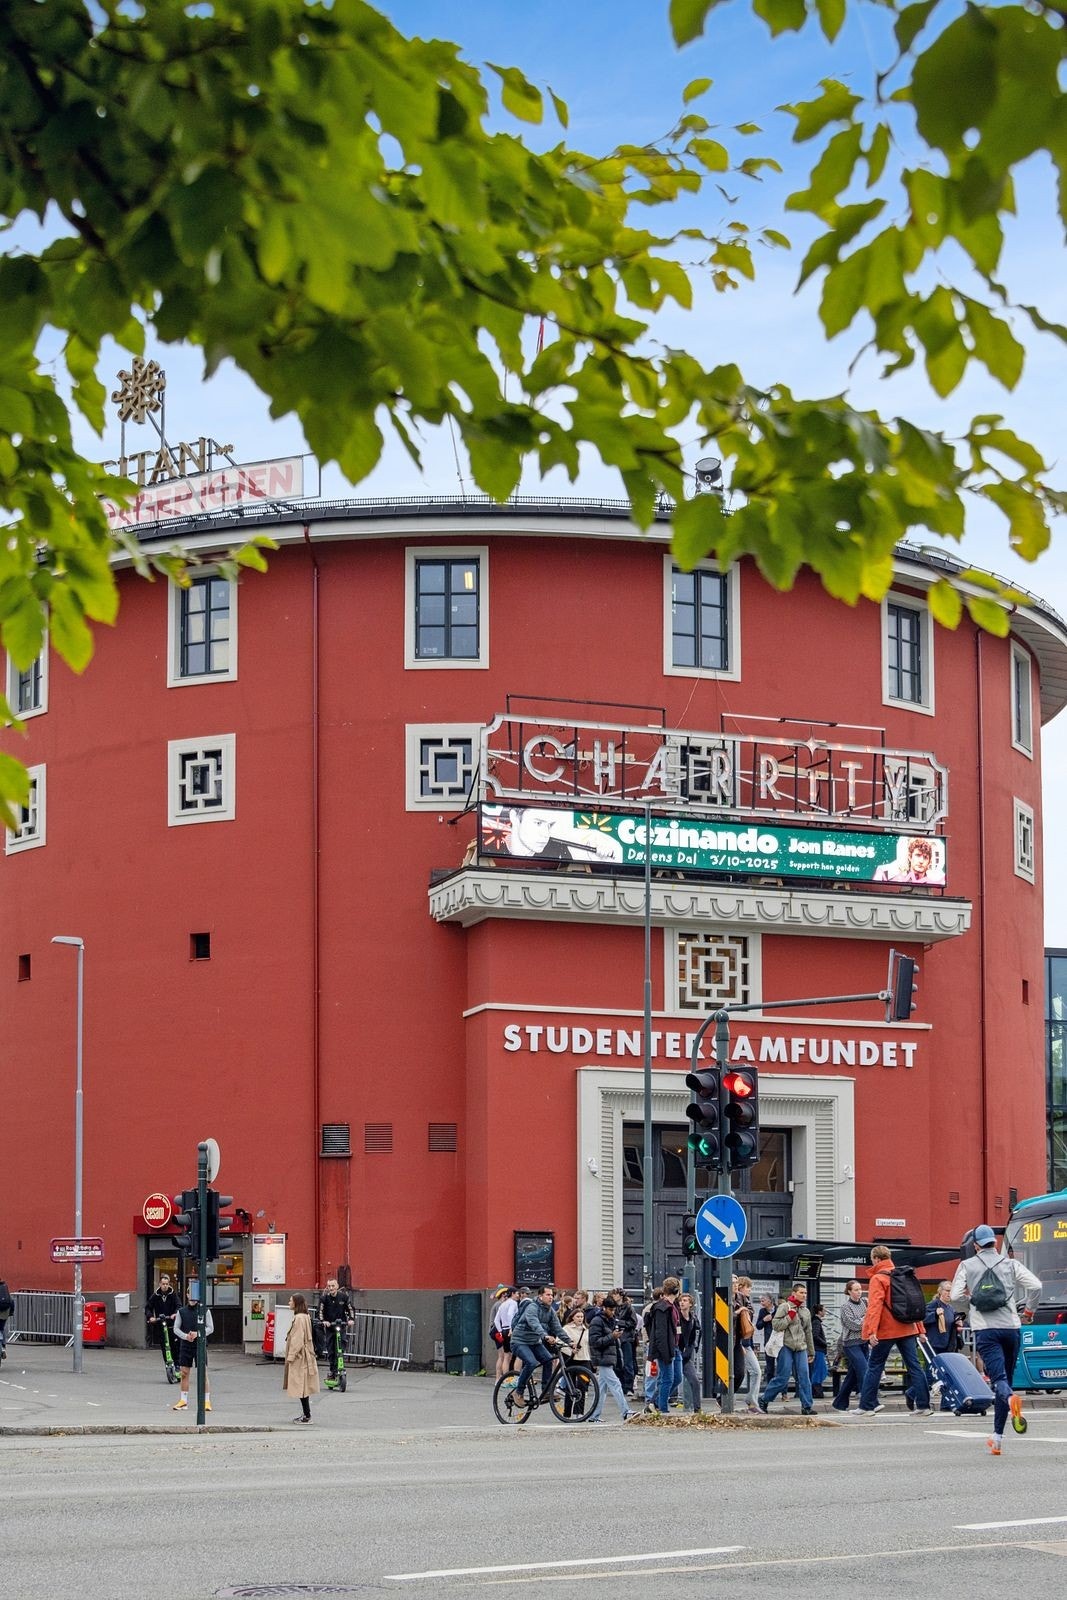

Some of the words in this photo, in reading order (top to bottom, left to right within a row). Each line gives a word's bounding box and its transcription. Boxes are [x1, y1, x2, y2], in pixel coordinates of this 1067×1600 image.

[99, 437, 206, 487] ITAN
[617, 818, 779, 855] Cezinando
[627, 848, 673, 863] Døens
[677, 848, 697, 866] Dal
[709, 854, 779, 870] 3/10-2025
[788, 837, 821, 855] Jon
[822, 840, 876, 859] Ranes
[146, 1207, 165, 1220] sesam
[1022, 1223, 1042, 1243] 310
